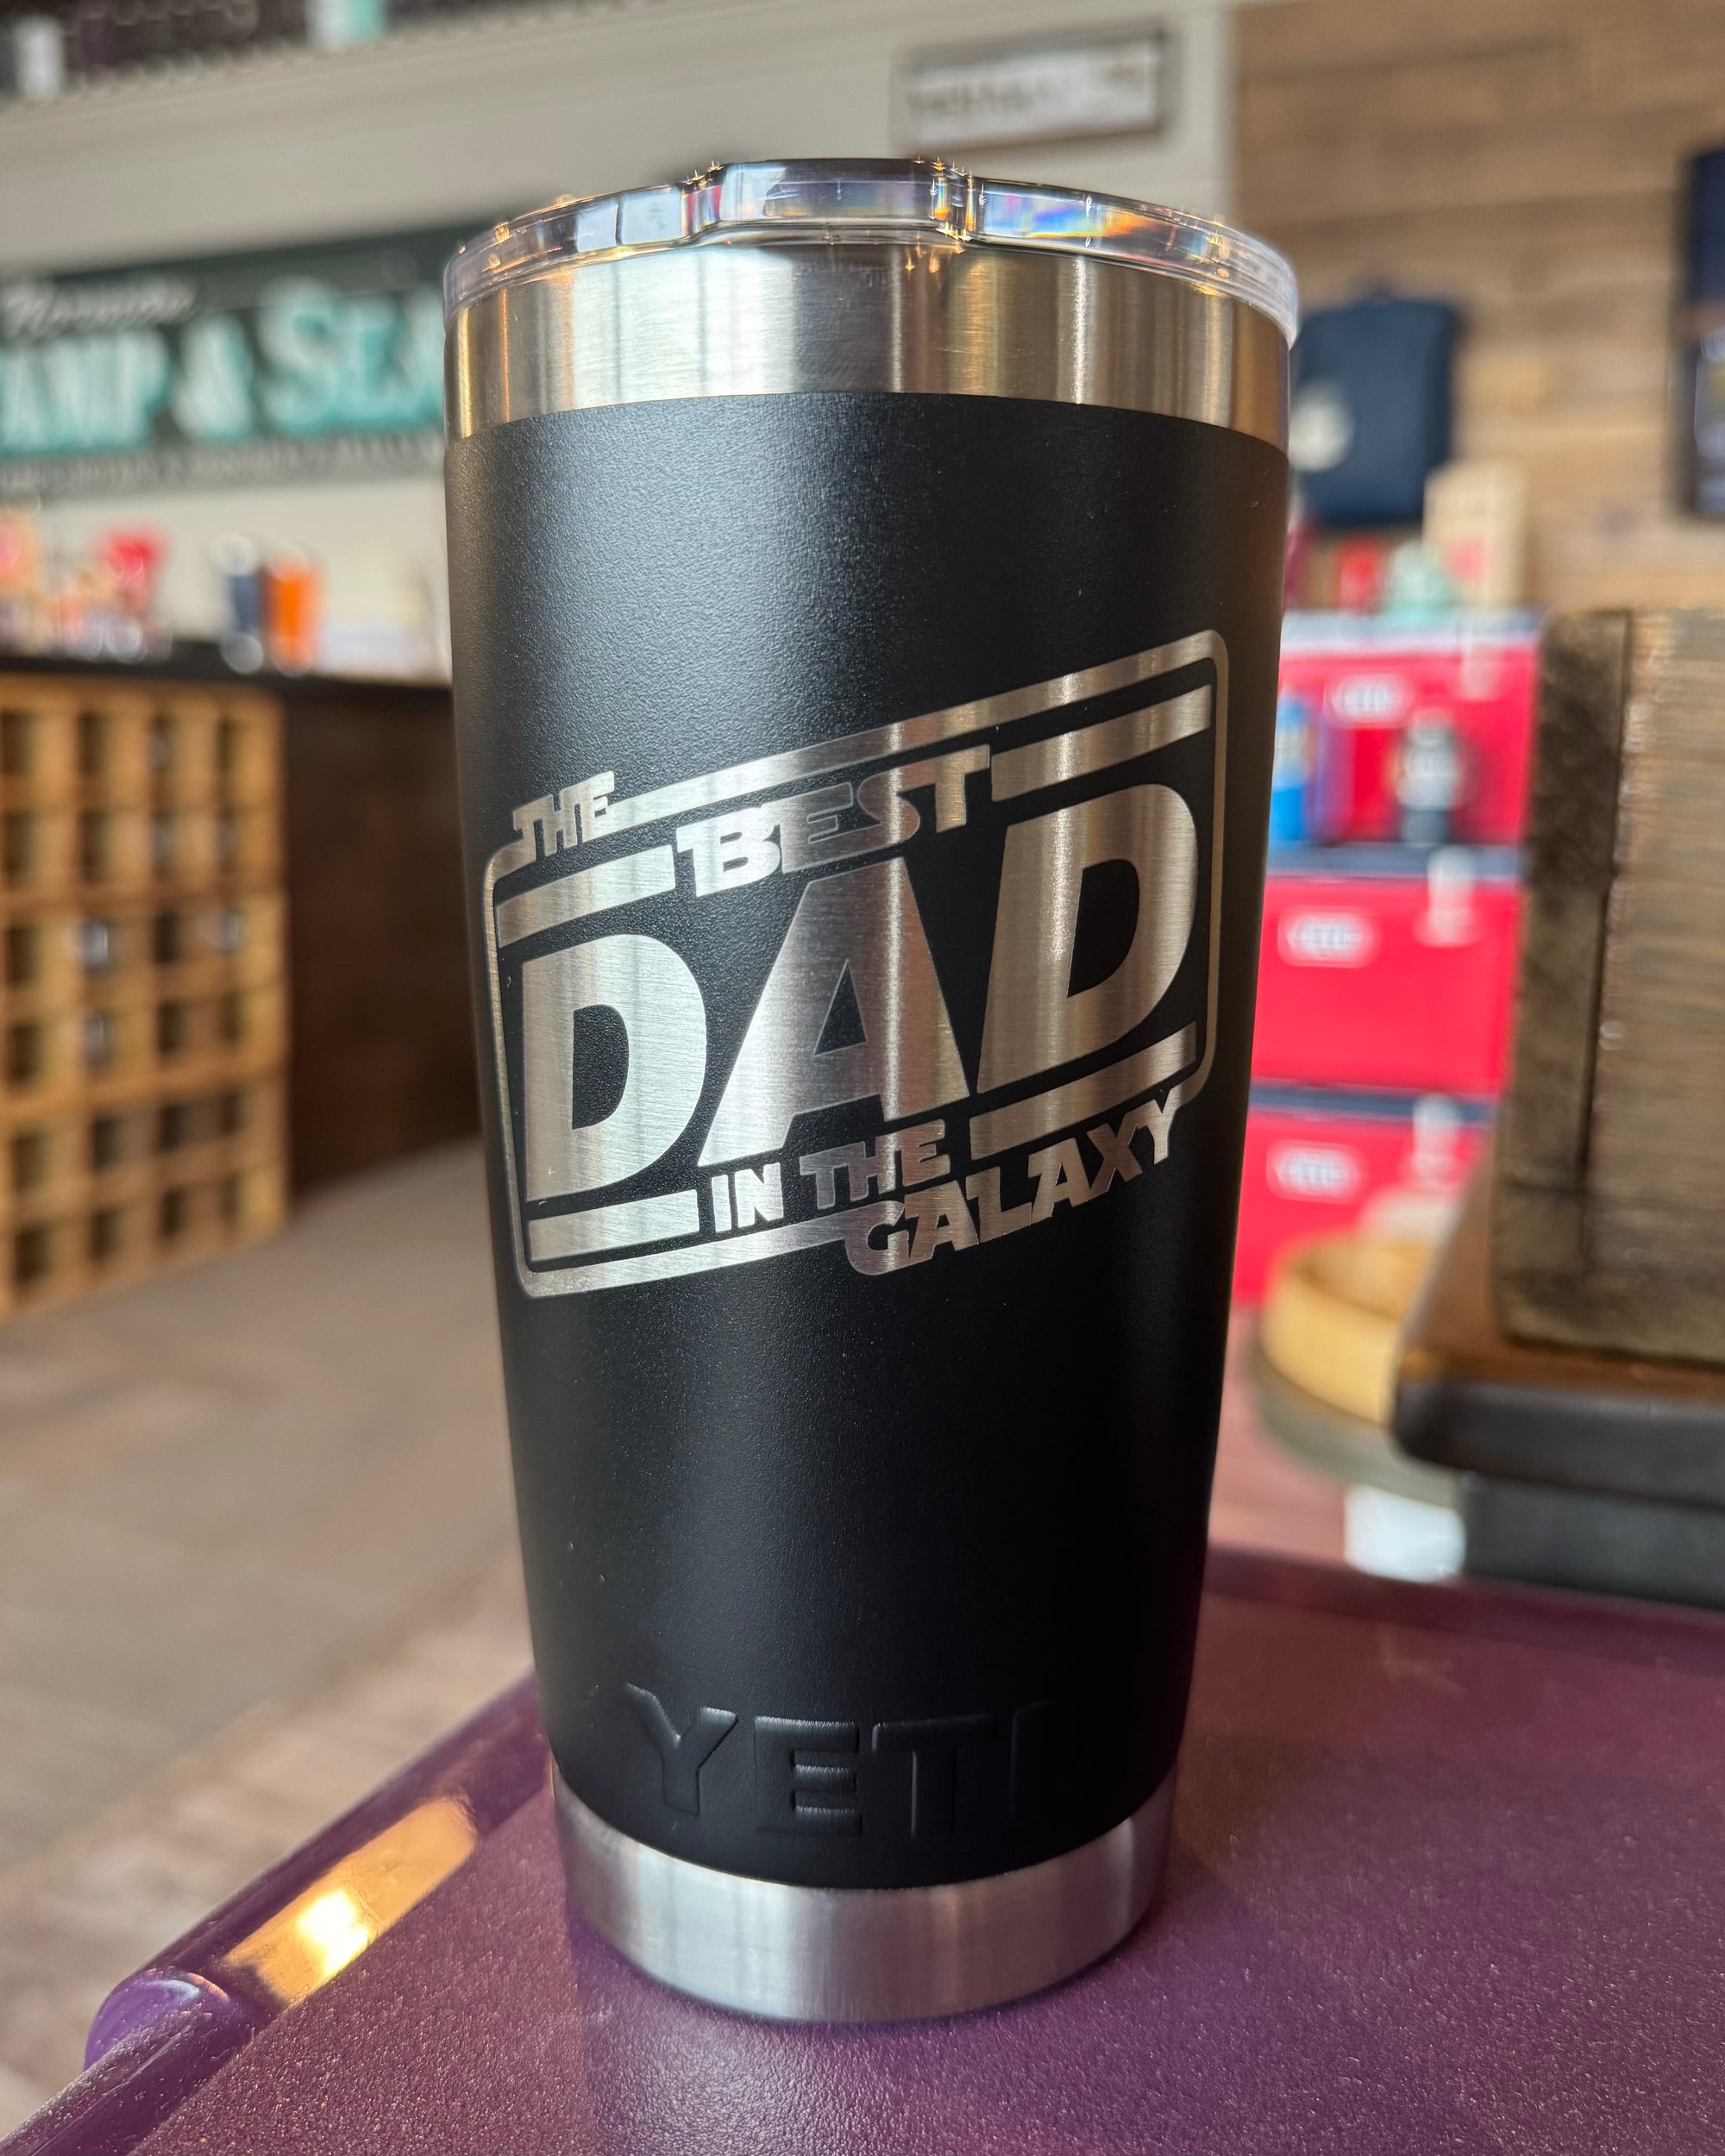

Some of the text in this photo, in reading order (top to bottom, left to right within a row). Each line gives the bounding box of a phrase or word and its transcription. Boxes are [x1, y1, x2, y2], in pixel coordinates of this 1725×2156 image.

[512, 744, 991, 897] THE BEST
[521, 783, 1199, 1202] DAD
[712, 1119, 950, 1233] IN THE
[845, 1085, 1185, 1275] GALAXY
[623, 1680, 1068, 1837] YETI
